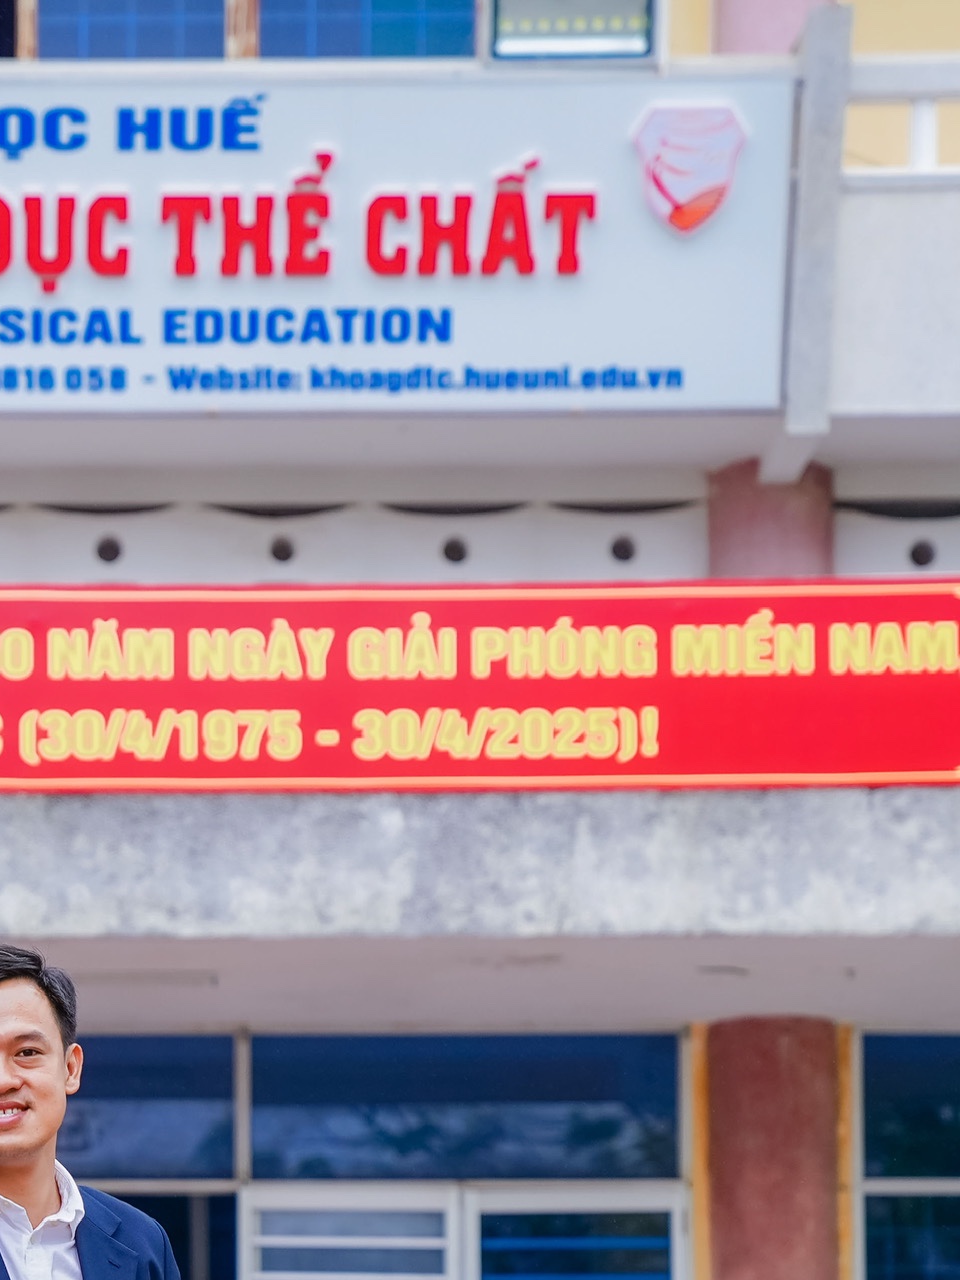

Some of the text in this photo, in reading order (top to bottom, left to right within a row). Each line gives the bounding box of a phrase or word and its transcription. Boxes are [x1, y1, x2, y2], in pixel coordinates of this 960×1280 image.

[116, 93, 267, 152] HUẾ
[161, 153, 334, 276] THỂ
[366, 157, 596, 276] CHẤT
[162, 307, 453, 345] EDUCATION
[46, 618, 175, 680] NĂM
[187, 618, 335, 680] NGÀY
[348, 612, 458, 680] GIẢI
[470, 616, 658, 679] PHÓNG
[828, 620, 959, 676] NAM
[18, 708, 304, 765] (30/4/1975
[316, 729, 340, 746] -
[352, 706, 660, 762] 30/4/2025)!
